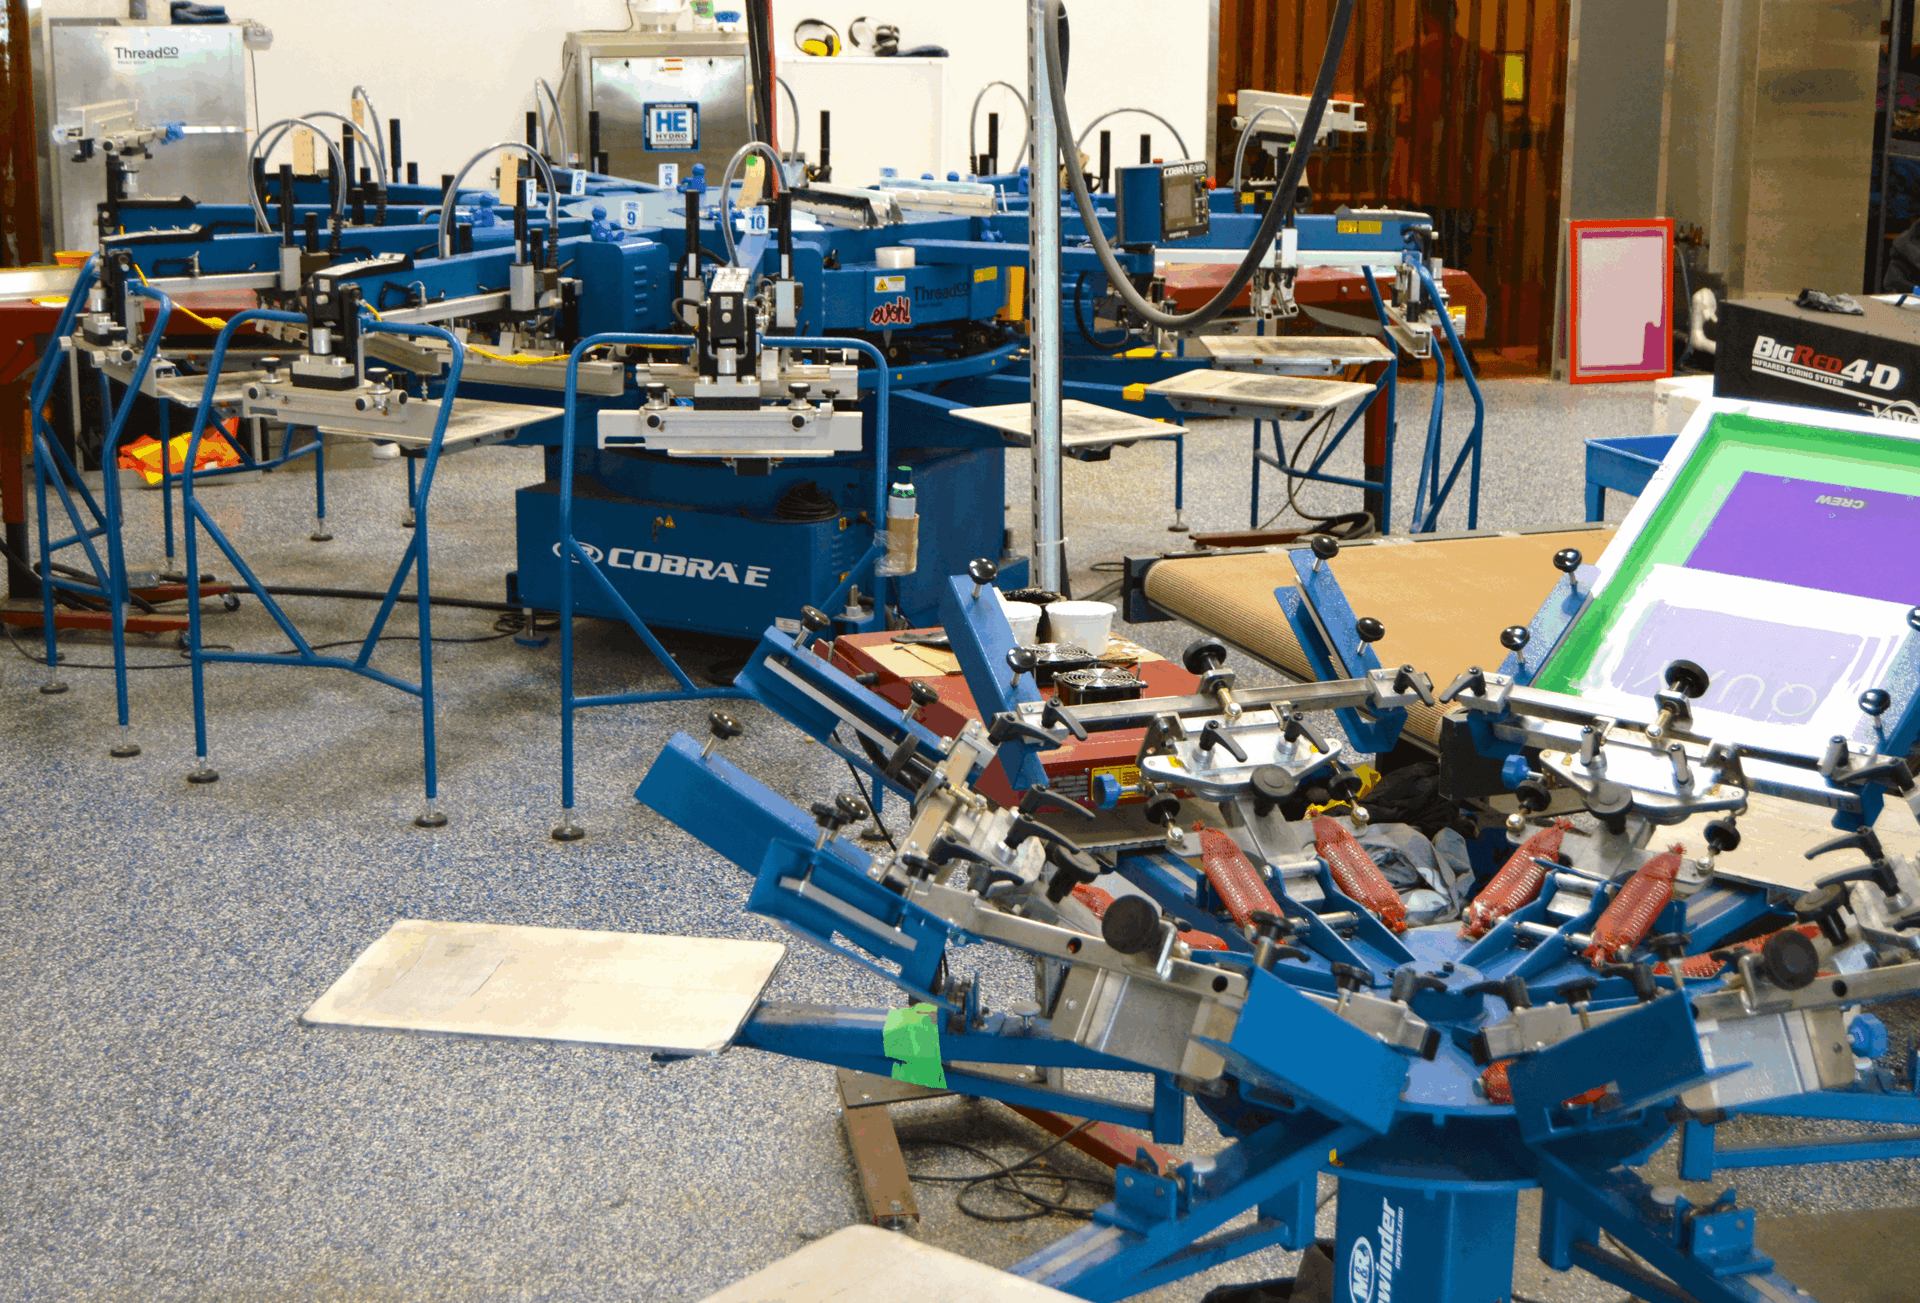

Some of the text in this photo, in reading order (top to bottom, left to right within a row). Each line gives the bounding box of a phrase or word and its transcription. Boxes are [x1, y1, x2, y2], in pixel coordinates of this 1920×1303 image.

[656, 111, 687, 132] HE
[664, 173, 672, 186] 5
[627, 211, 636, 226] 9
[749, 215, 765, 230] 10
[1751, 358, 1844, 387] INFRARED CURING SYSTEM
[1815, 495, 1866, 509] CREW
[608, 547, 739, 584] COBRA
[744, 565, 771, 587] E
[1395, 1206, 1404, 1270] mrprint.com
[1375, 1196, 1396, 1303] winder
